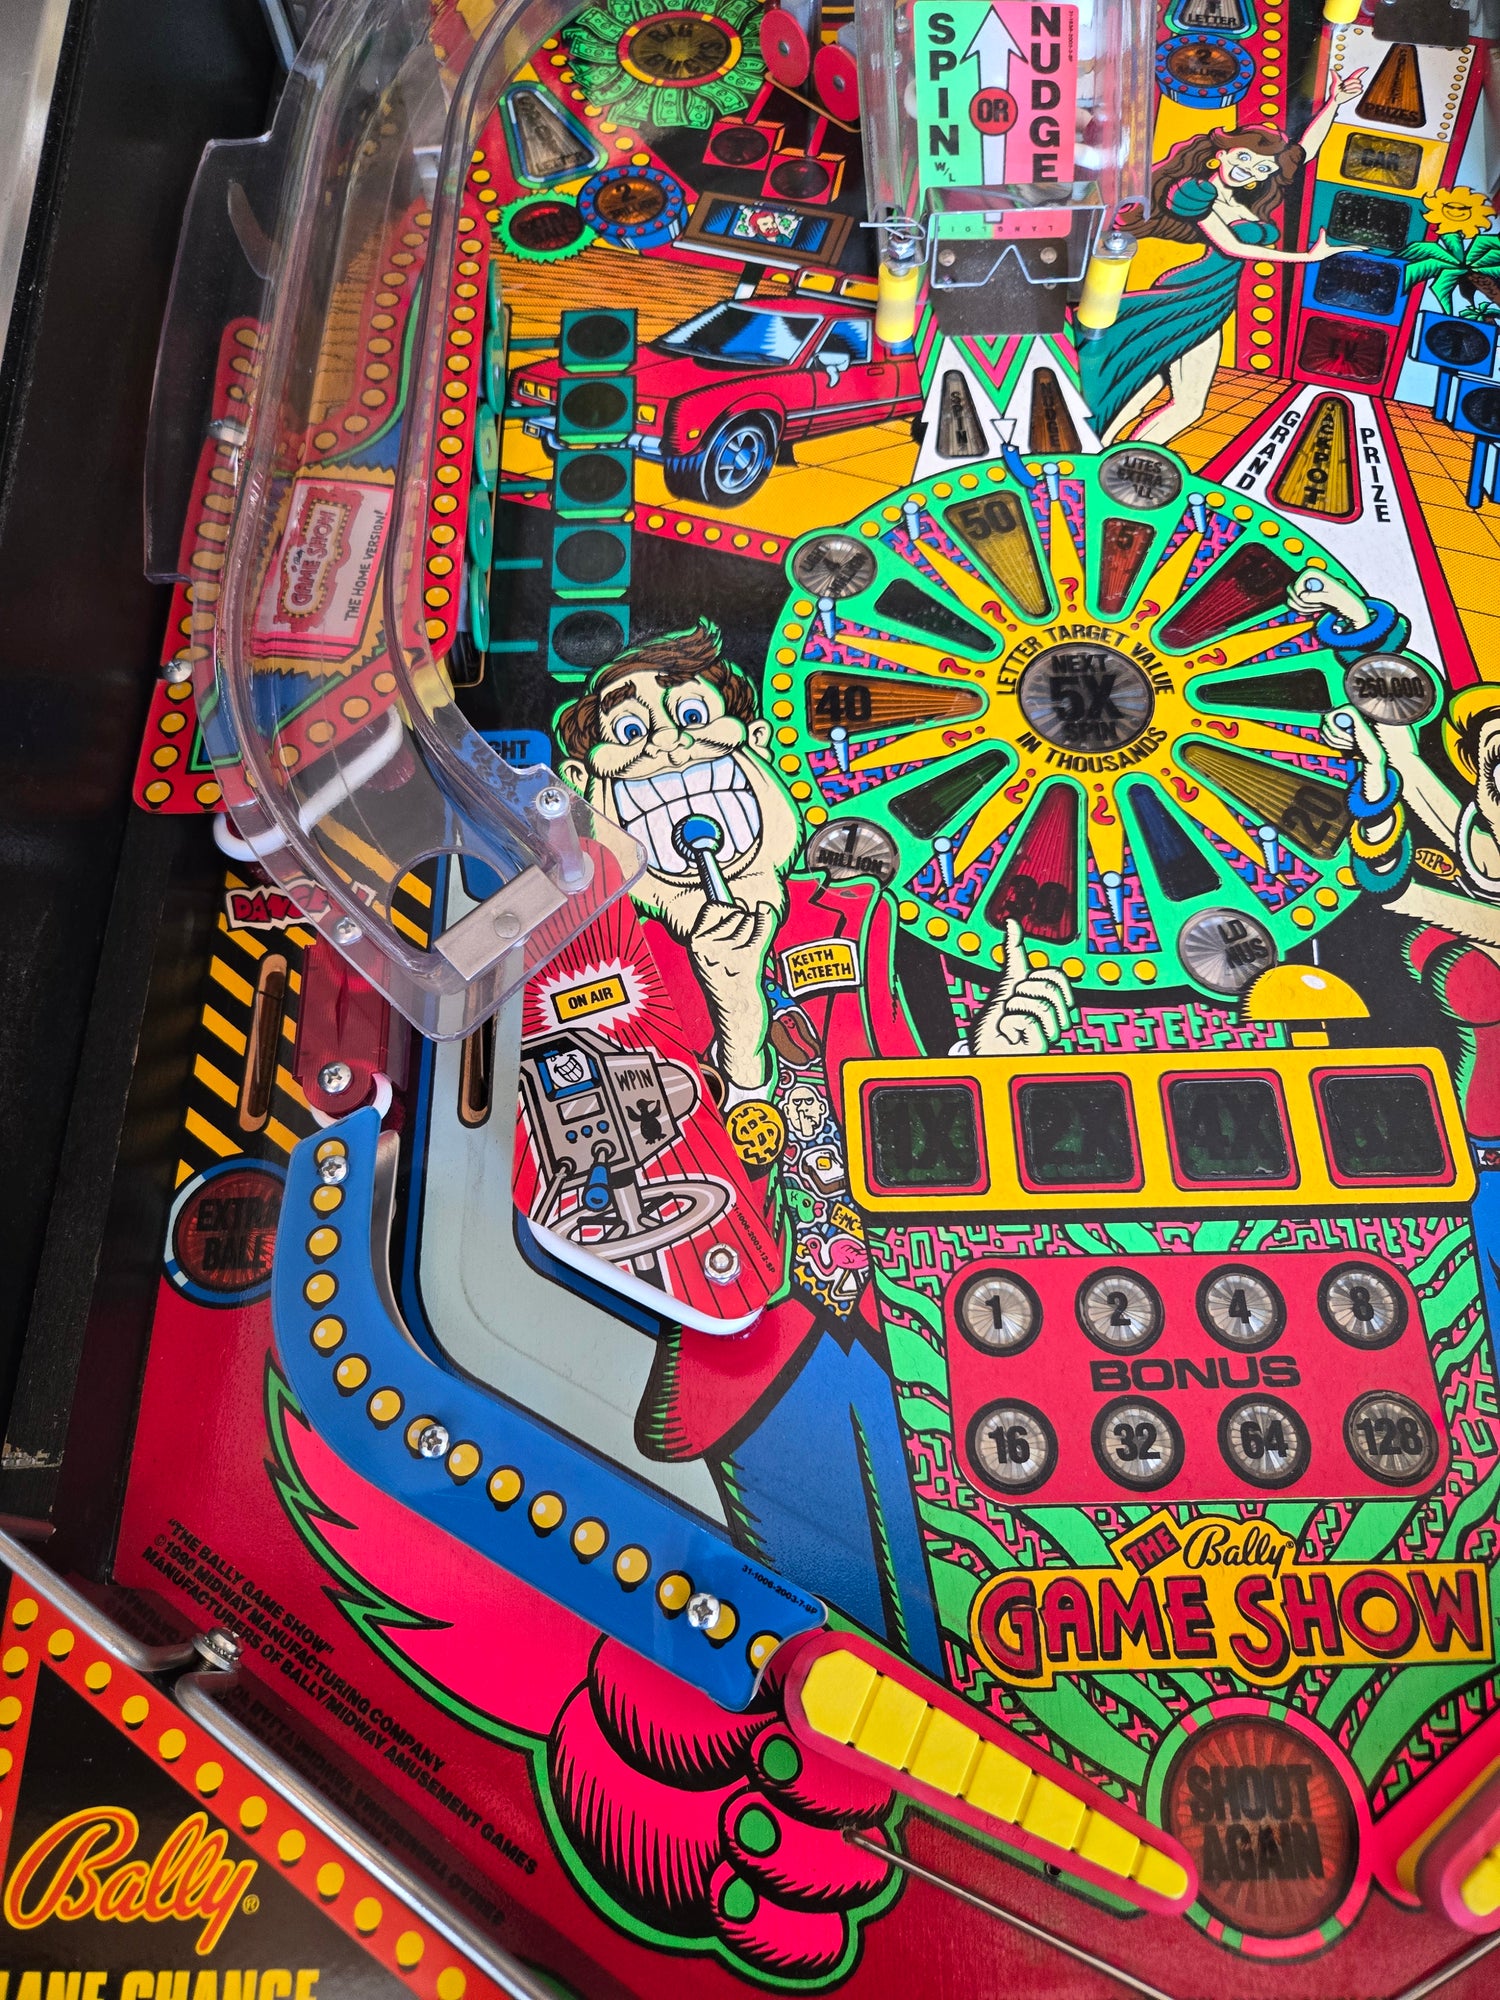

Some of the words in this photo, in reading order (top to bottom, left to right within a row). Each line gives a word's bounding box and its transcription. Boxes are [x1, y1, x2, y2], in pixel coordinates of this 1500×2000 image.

[928, 13, 960, 156] SPIN
[1030, 7, 1061, 183] NUDGE
[977, 99, 1009, 123] OR
[1361, 148, 1400, 172] CAR
[949, 391, 968, 444] SPIN
[1124, 456, 1163, 474] LITES
[1236, 410, 1301, 491] GRAND
[1304, 403, 1335, 505] JACKPOT
[1360, 428, 1390, 523] PRIZE
[961, 500, 1017, 541] 50
[291, 560, 321, 606] GAME
[307, 510, 336, 559] SHOW
[344, 599, 360, 621] THE
[352, 563, 371, 598] HOME
[362, 510, 387, 561] VERSION!
[996, 636, 1043, 695] LETTER
[1043, 624, 1129, 648] TARGET
[1131, 642, 1175, 695] VALUE
[1051, 654, 1109, 674] NEXT
[815, 684, 872, 722] 40
[1049, 675, 1125, 721] 5X
[1352, 677, 1425, 701] 250,000
[1016, 731, 1043, 754] IN
[1045, 726, 1168, 773] THOUSANDS
[1282, 781, 1345, 843] 20
[842, 823, 858, 853] 1
[792, 949, 834, 968] KEITH
[793, 963, 851, 983] McTEETH
[568, 995, 588, 1010] ON
[590, 987, 614, 1003] AIR
[614, 1069, 655, 1093] WPIN
[985, 1295, 1003, 1329] 1
[1107, 1291, 1131, 1326] 2
[1229, 1288, 1251, 1323] 4
[1351, 1286, 1375, 1321] 8
[1090, 1355, 1302, 1392] BONUS
[988, 1425, 1030, 1464] 16
[1113, 1422, 1161, 1461] 32
[1240, 1419, 1289, 1459] 64
[1356, 1416, 1422, 1456] 128
[1127, 1527, 1179, 1576] THE
[197, 1545, 243, 1586] BALLY
[241, 1581, 284, 1619] GAME
[976, 1575, 1219, 1678] GAME
[1229, 1568, 1486, 1676] SHOW
[192, 1566, 251, 1616] MIDWAY
[245, 1609, 372, 1714] MANUFACTURING
[367, 1707, 445, 1773] COMPANY
[140, 1546, 263, 1649] MANUFACTURERS
[259, 1642, 283, 1665] OF
[278, 1659, 387, 1750] BALLY/MIDWAY
[383, 1744, 483, 1828] AMUSEMENT
[477, 1822, 539, 1875] GAMES
[1185, 1763, 1313, 1822] SHOOT
[1202, 1822, 1326, 1881] AGAIN
